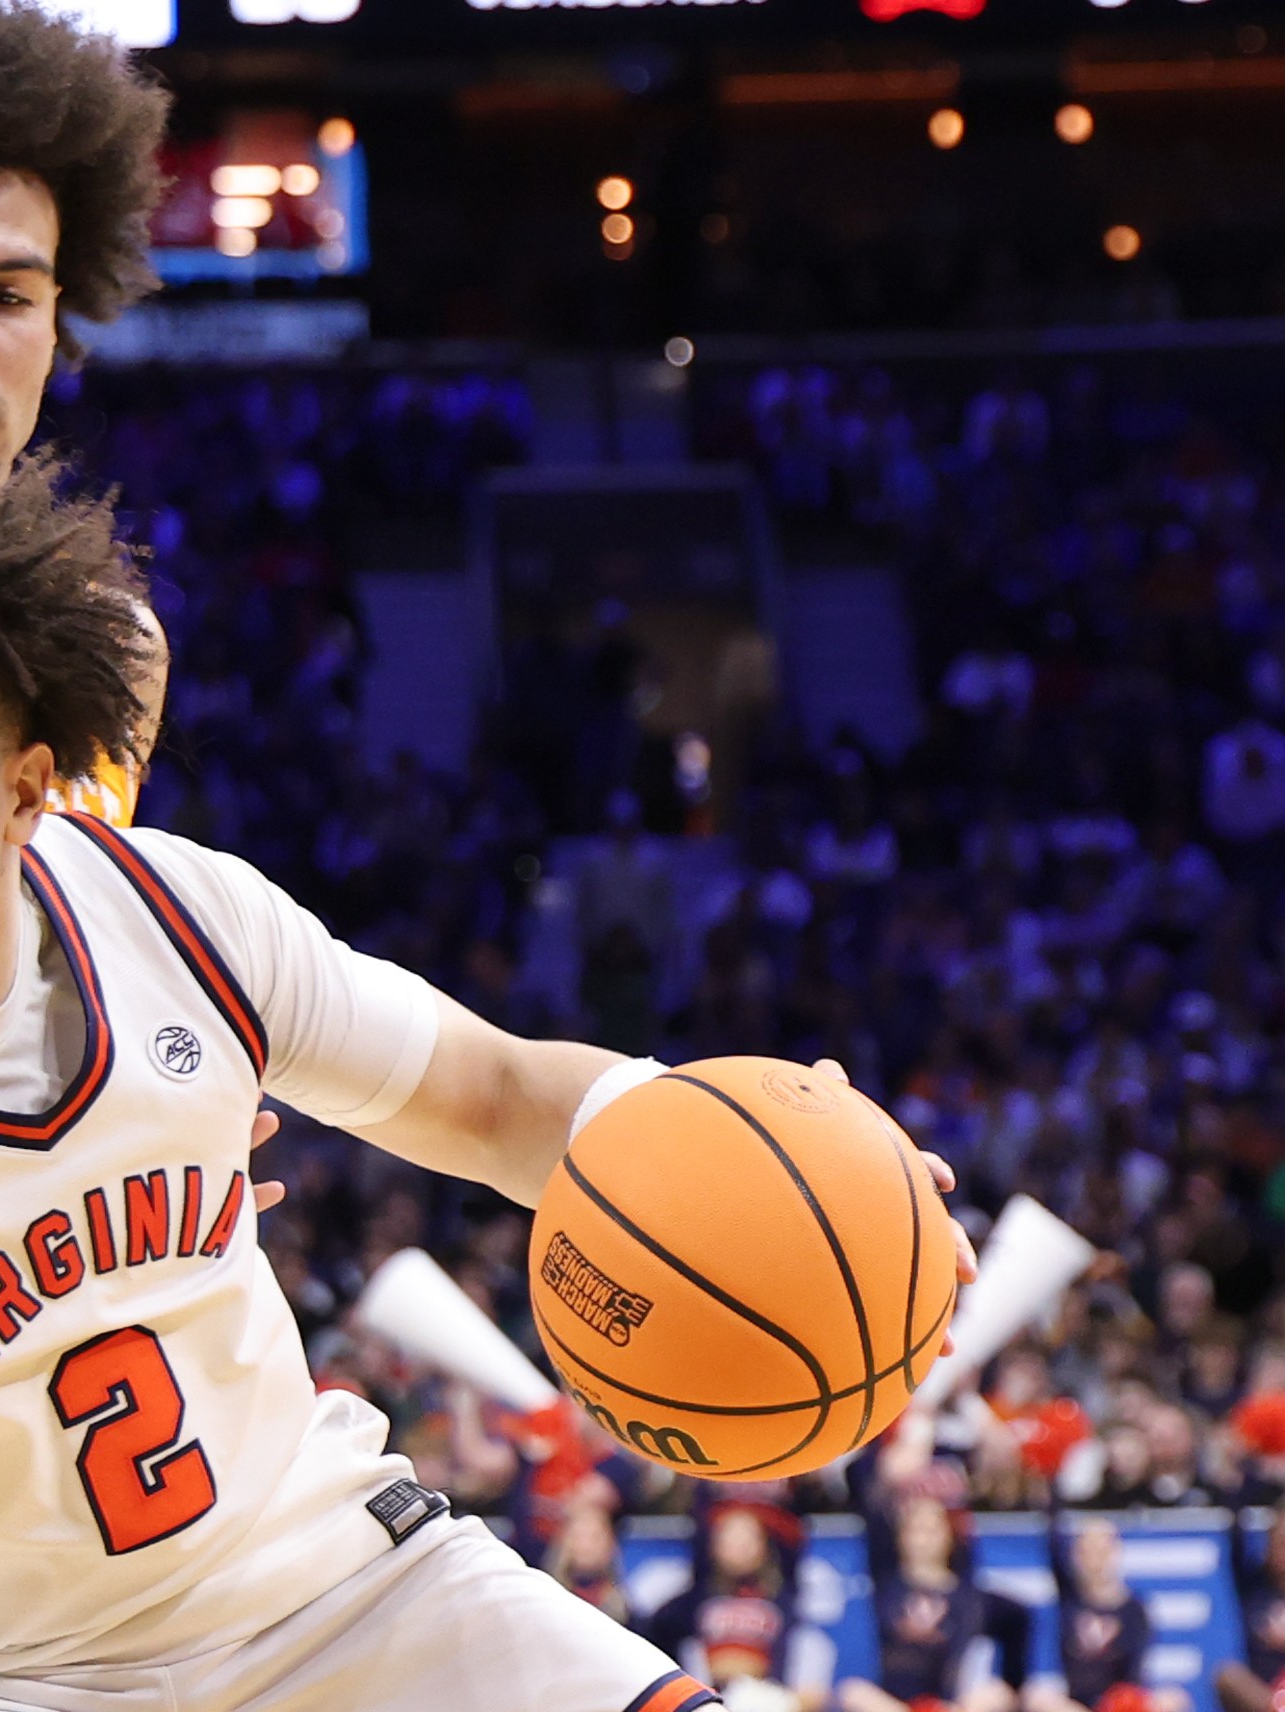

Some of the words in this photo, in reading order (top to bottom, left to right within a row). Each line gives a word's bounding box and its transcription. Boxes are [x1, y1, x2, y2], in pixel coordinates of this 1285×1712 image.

[166, 1031, 195, 1064] ACC
[548, 1235, 614, 1309] MADNESS
[556, 1275, 613, 1334] MARCH
[47, 1324, 218, 1556] 2
